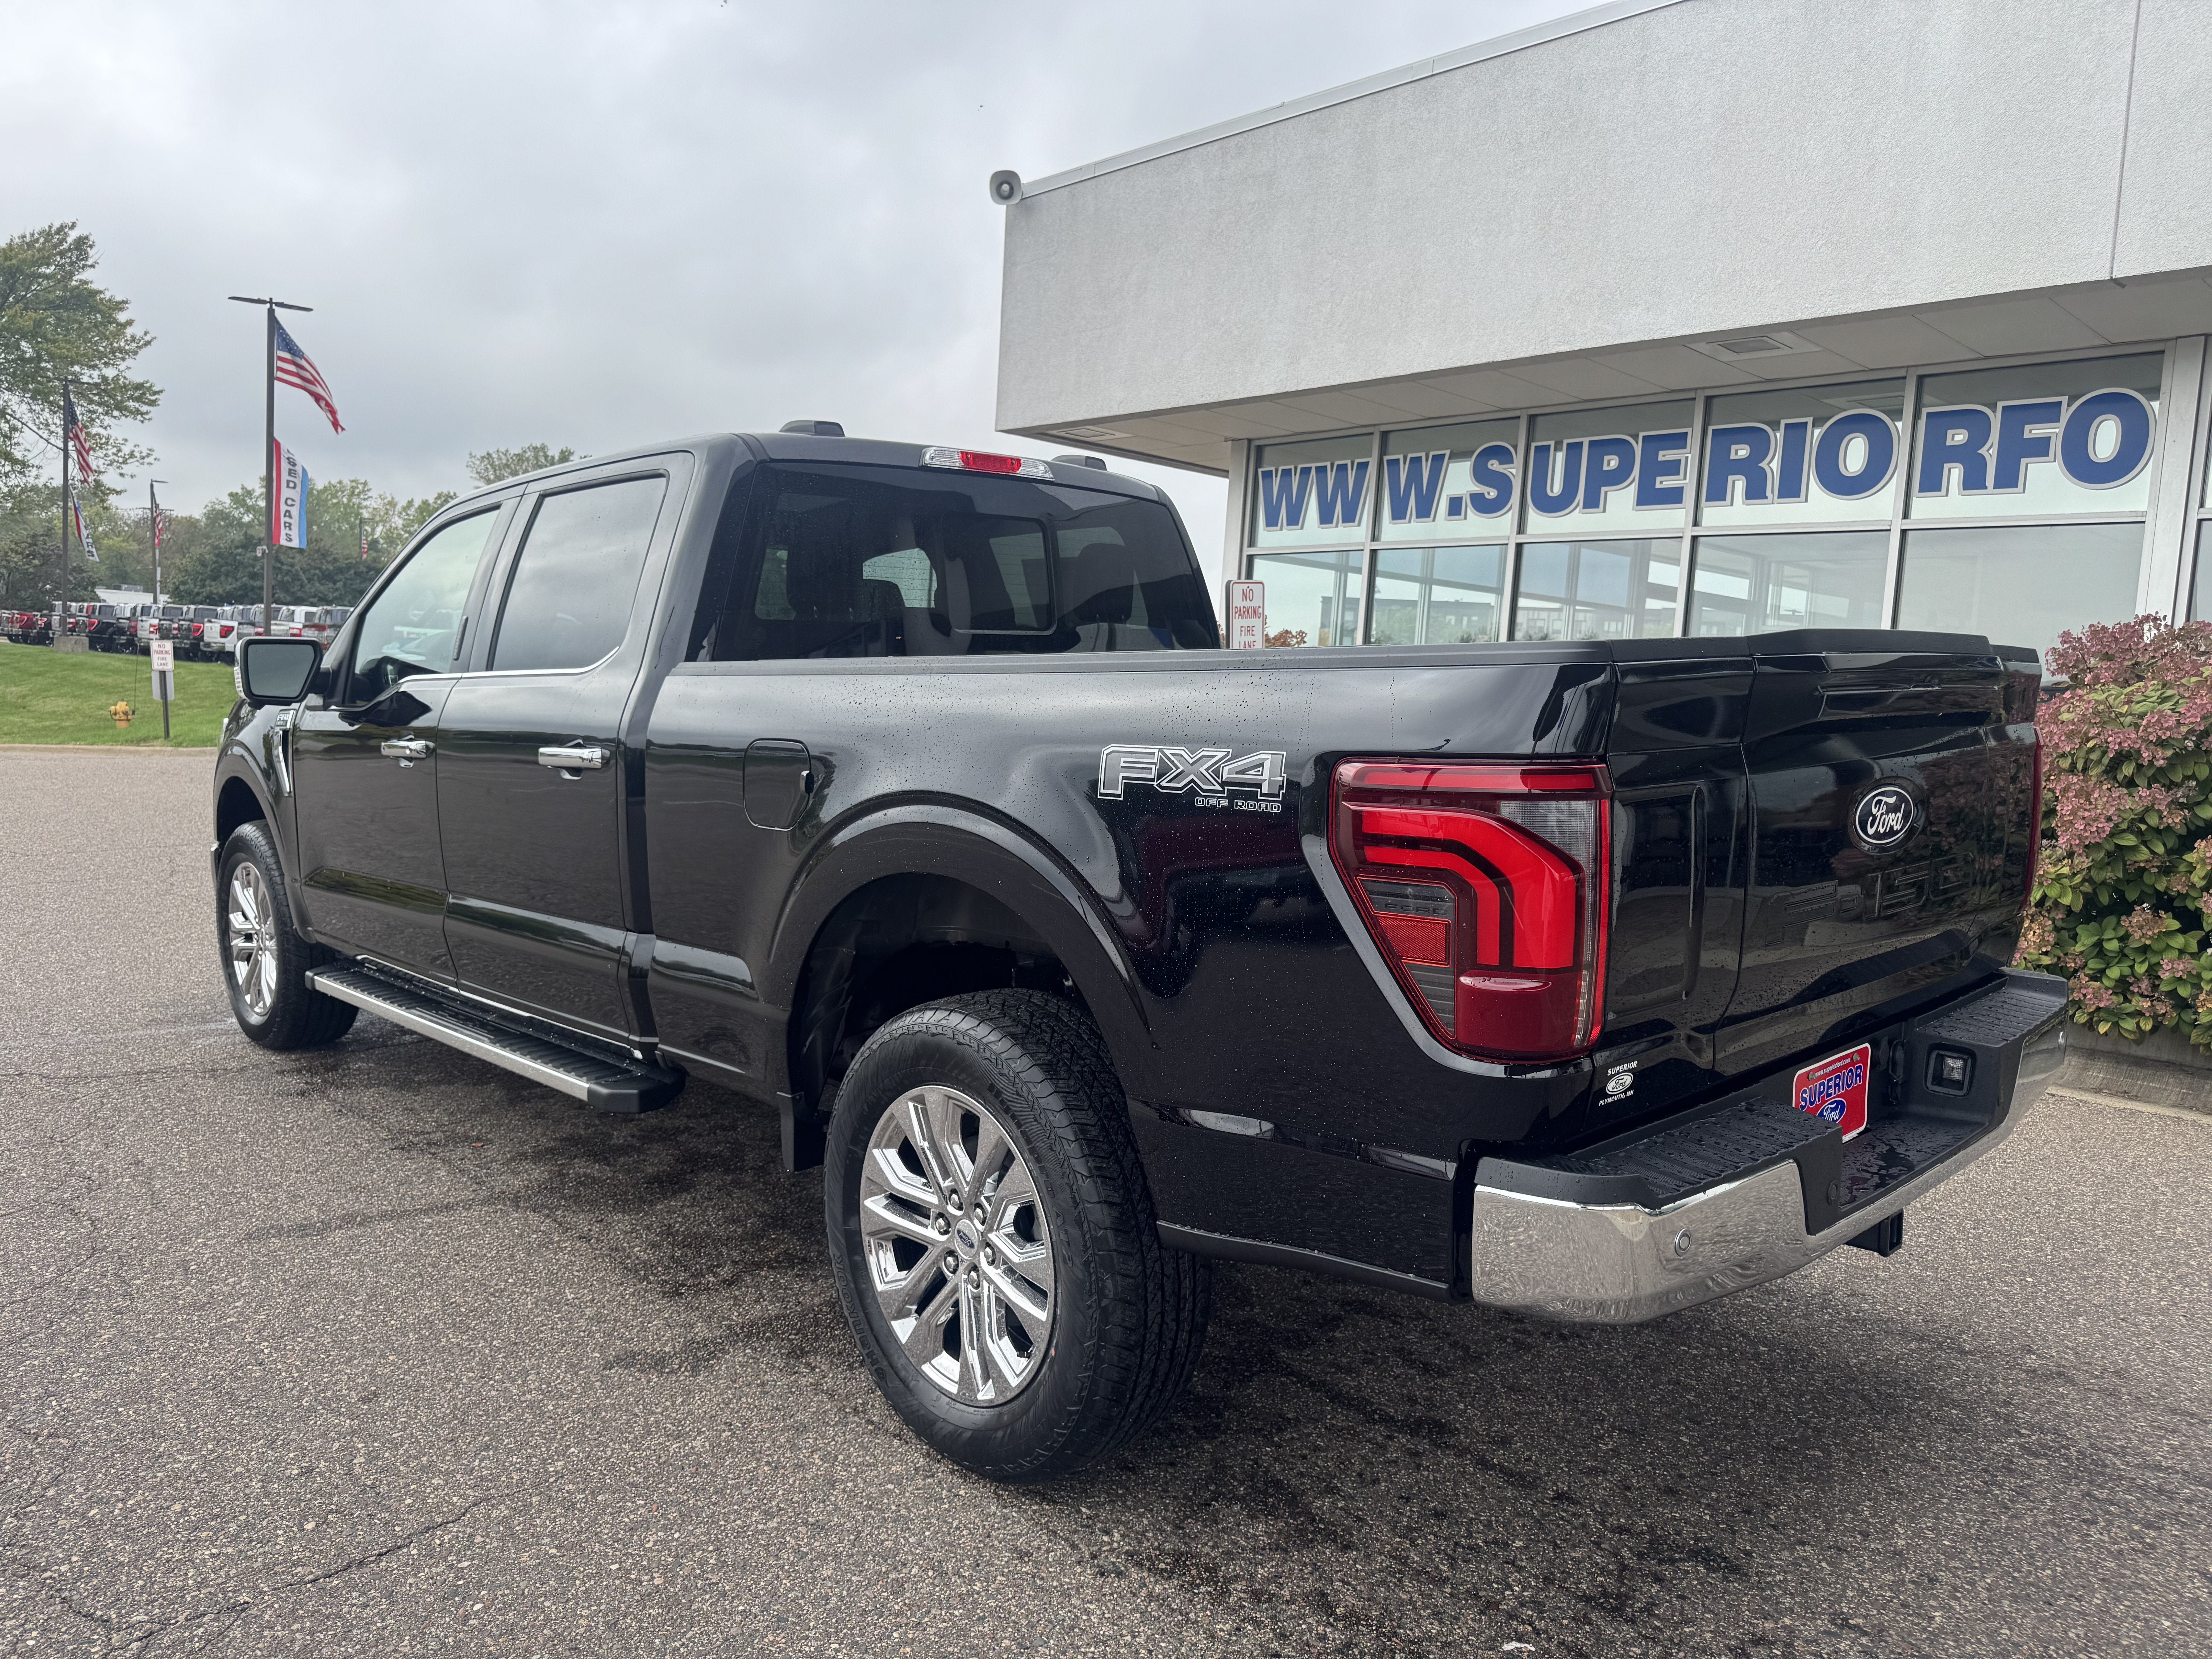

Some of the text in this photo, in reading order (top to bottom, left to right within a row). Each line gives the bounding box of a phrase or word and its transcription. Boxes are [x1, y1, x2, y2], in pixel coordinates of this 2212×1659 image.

[283, 497, 296, 543] CARS
[1242, 588, 1254, 602] NO
[1234, 606, 1261, 620] PARKING
[1240, 626, 1255, 637] FIRE
[1097, 744, 1286, 800] FX4
[1195, 797, 1281, 812] OFF ROAD
[1867, 795, 1905, 835] Ford
[1385, 903, 1448, 915] FORD
[1607, 1061, 1638, 1076] SUPERIOR
[1612, 1077, 1629, 1090] Ford
[1799, 1063, 1863, 1111] SUPERIOR
[1599, 1092, 1625, 1106] PLYMOUTH,
[1821, 1103, 1840, 1122] Ford
[959, 1231, 972, 1246] Ford
